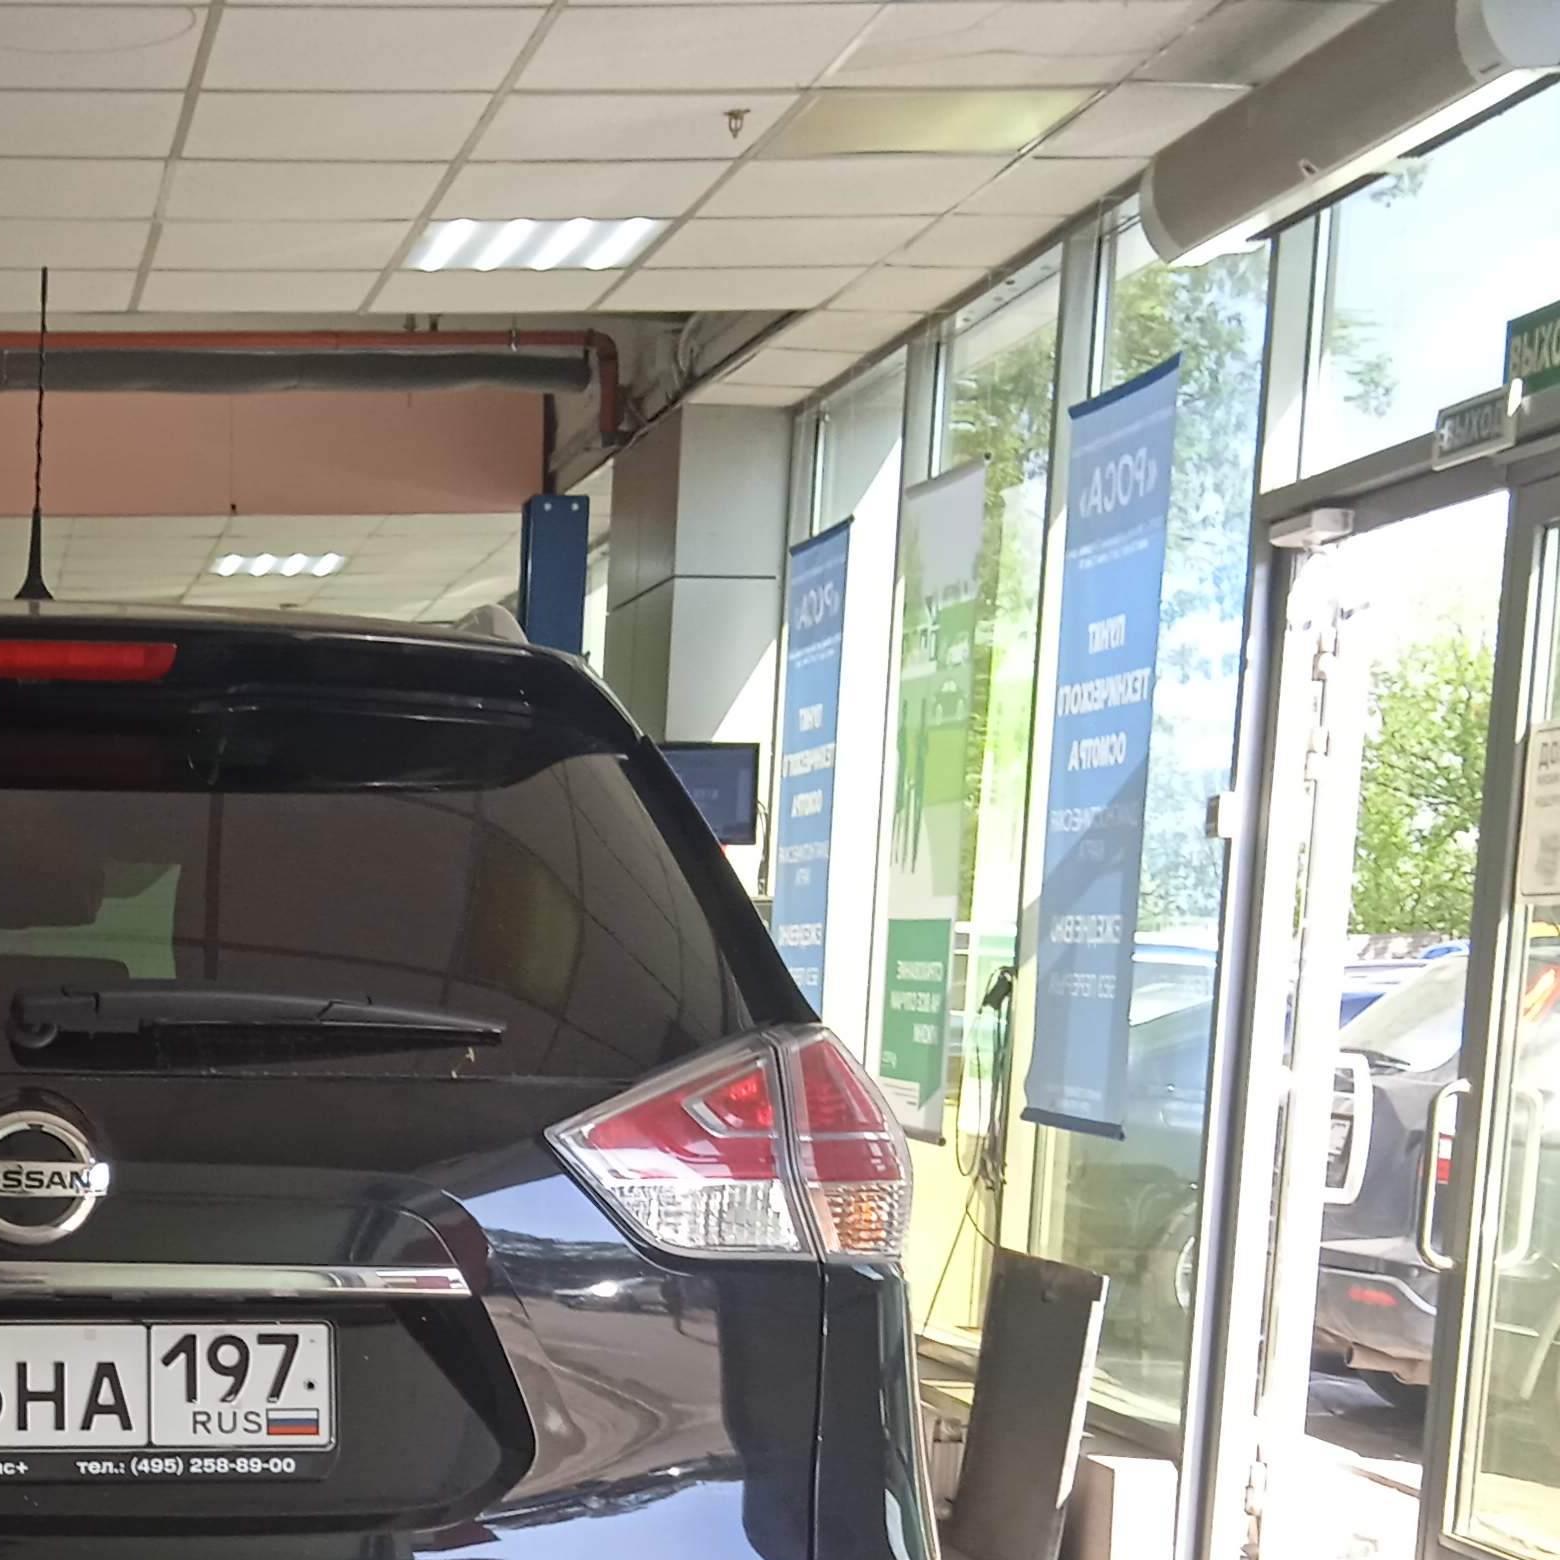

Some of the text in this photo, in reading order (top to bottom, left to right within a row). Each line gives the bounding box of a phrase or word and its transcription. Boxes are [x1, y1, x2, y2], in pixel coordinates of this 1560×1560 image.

[161, 1332, 301, 1404] 197
[192, 1411, 263, 1435] RUS
[130, 1457, 184, 1476] (495)
[189, 1458, 296, 1474] 258-89-00
